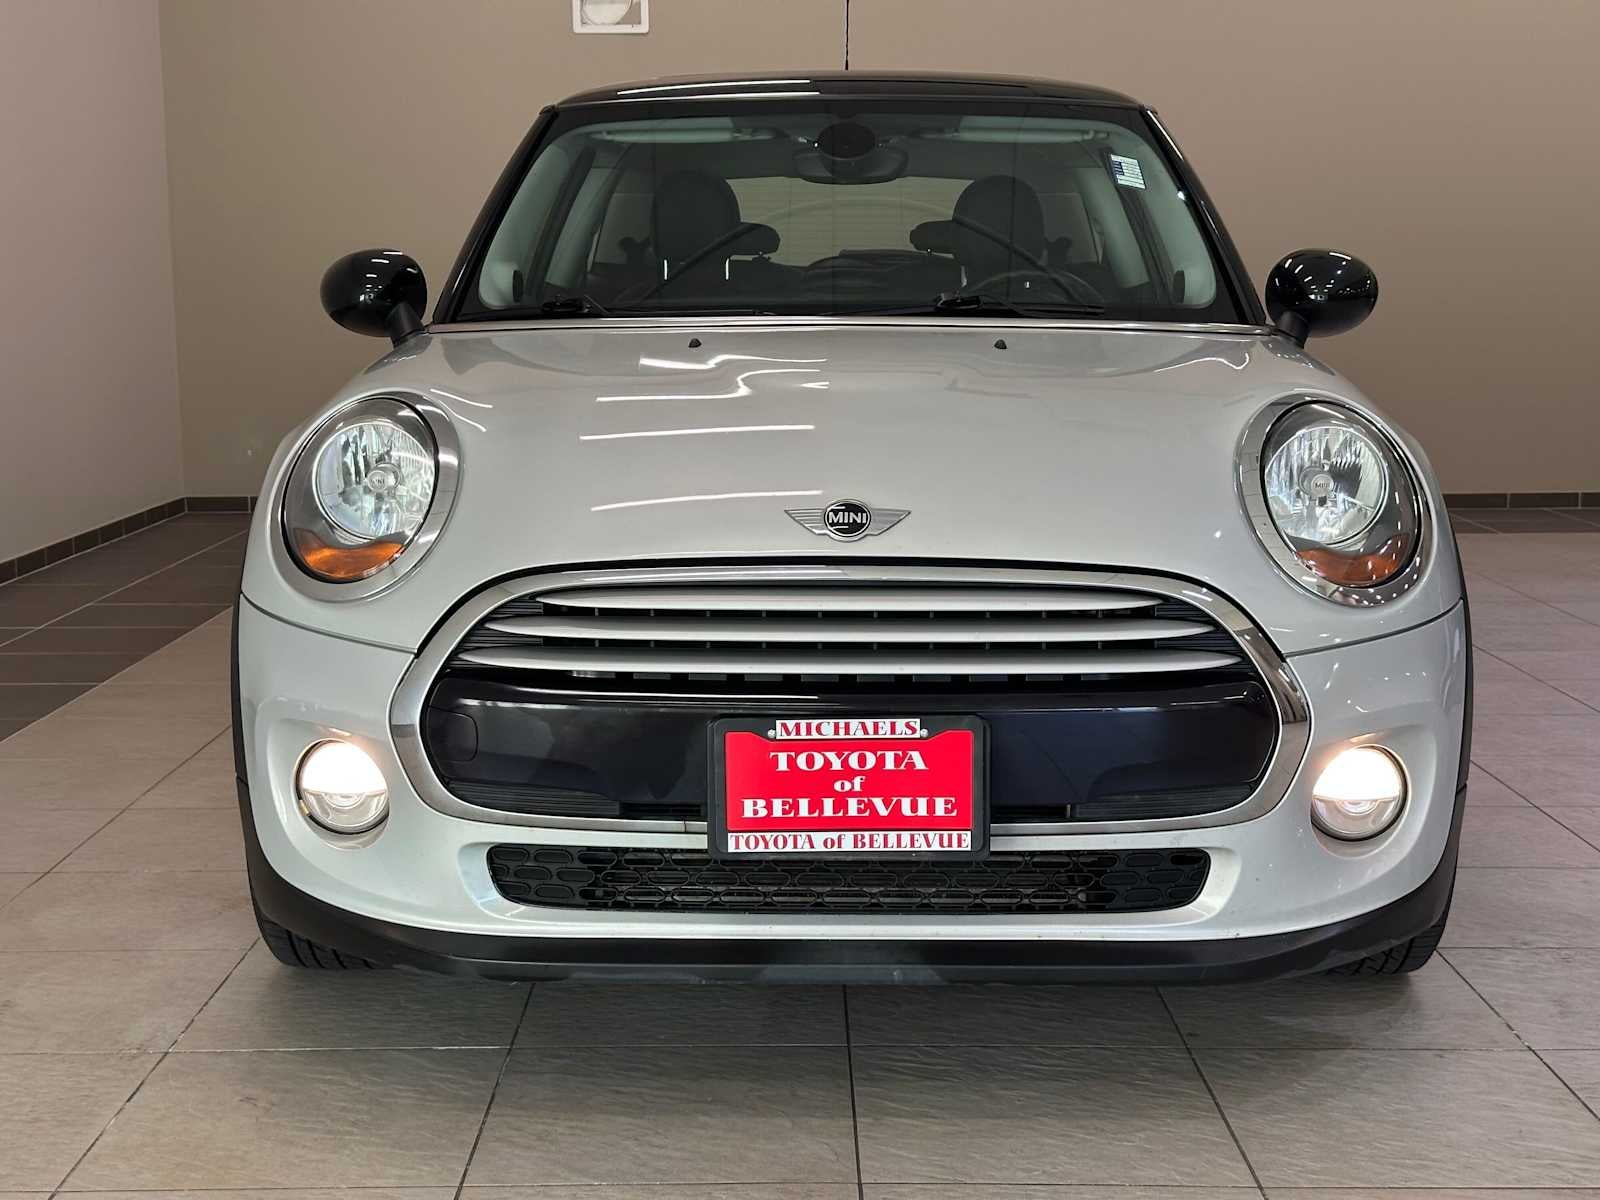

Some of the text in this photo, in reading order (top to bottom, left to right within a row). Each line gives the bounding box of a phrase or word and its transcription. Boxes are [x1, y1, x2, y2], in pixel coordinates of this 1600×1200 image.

[828, 511, 867, 524] MINI
[779, 720, 918, 737] MICHAELS
[770, 751, 928, 771] TOYOTA
[833, 775, 866, 792] of
[741, 797, 958, 818] BELLEVUE
[730, 832, 969, 850] TOYOTA of BELLEVUE
